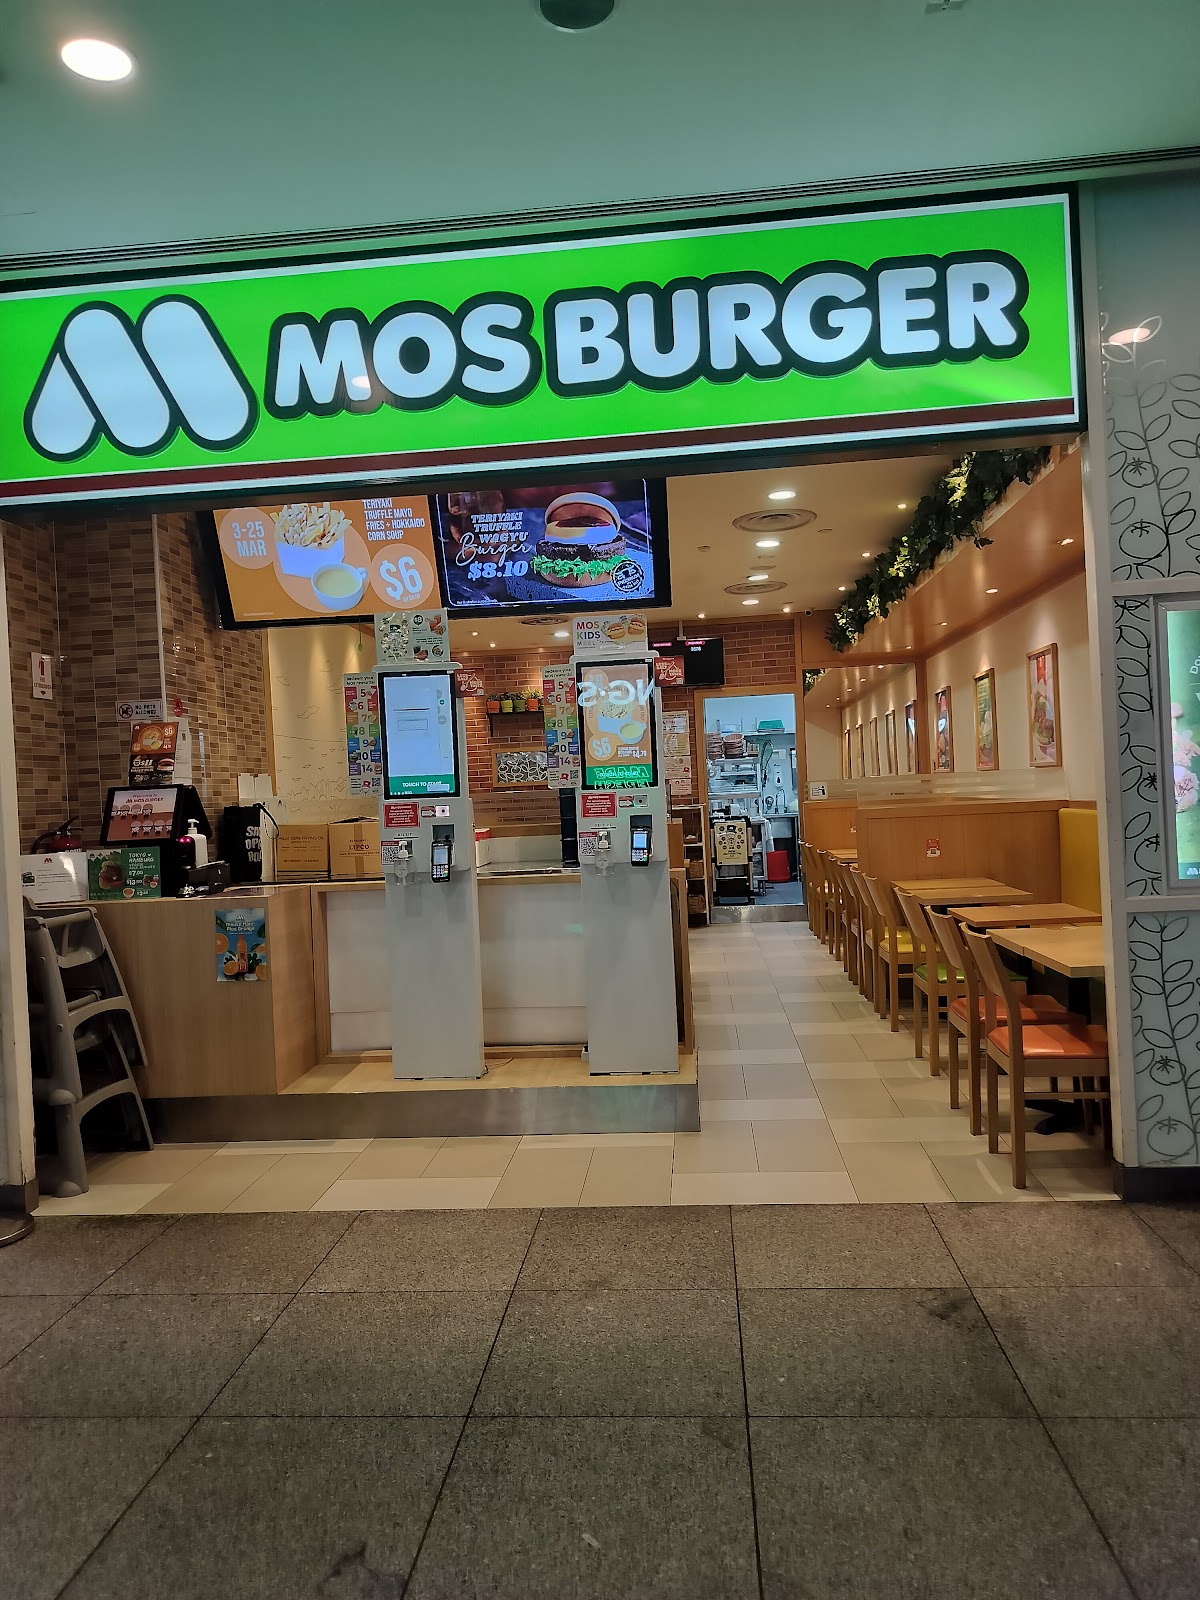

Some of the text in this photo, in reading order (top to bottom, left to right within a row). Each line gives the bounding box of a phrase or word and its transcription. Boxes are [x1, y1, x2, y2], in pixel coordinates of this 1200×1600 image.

[270, 256, 1023, 412] MOS BURGER
[362, 498, 392, 509] TERIYAKI
[364, 507, 412, 520] TRUFFLE MAYO
[470, 511, 524, 523] TERIYAKI
[366, 519, 385, 530] FRIES
[391, 517, 425, 529] HOKKAIDO
[473, 522, 523, 533] TRUFFLE
[231, 521, 265, 539] 3-25
[367, 529, 404, 541] CORN SOUP
[478, 532, 529, 544] WAGYU
[236, 539, 267, 557] MAR
[455, 532, 533, 567] Burger
[467, 560, 529, 581] $8.10
[379, 556, 423, 601] $6
[576, 621, 600, 630] MOS
[576, 631, 601, 640] KIDS
[558, 681, 563, 689] 5
[360, 689, 366, 697] 5
[555, 694, 562, 702] 6
[357, 701, 364, 710] 6
[560, 706, 566, 715] 7
[361, 714, 368, 722] 7
[557, 719, 563, 728] 8
[164, 728, 173, 736] $6
[358, 727, 365, 735] 8
[560, 731, 567, 739] 9
[362, 739, 369, 747] 9
[592, 737, 611, 758] $6
[559, 757, 571, 765] 14
[361, 764, 373, 773] 14
